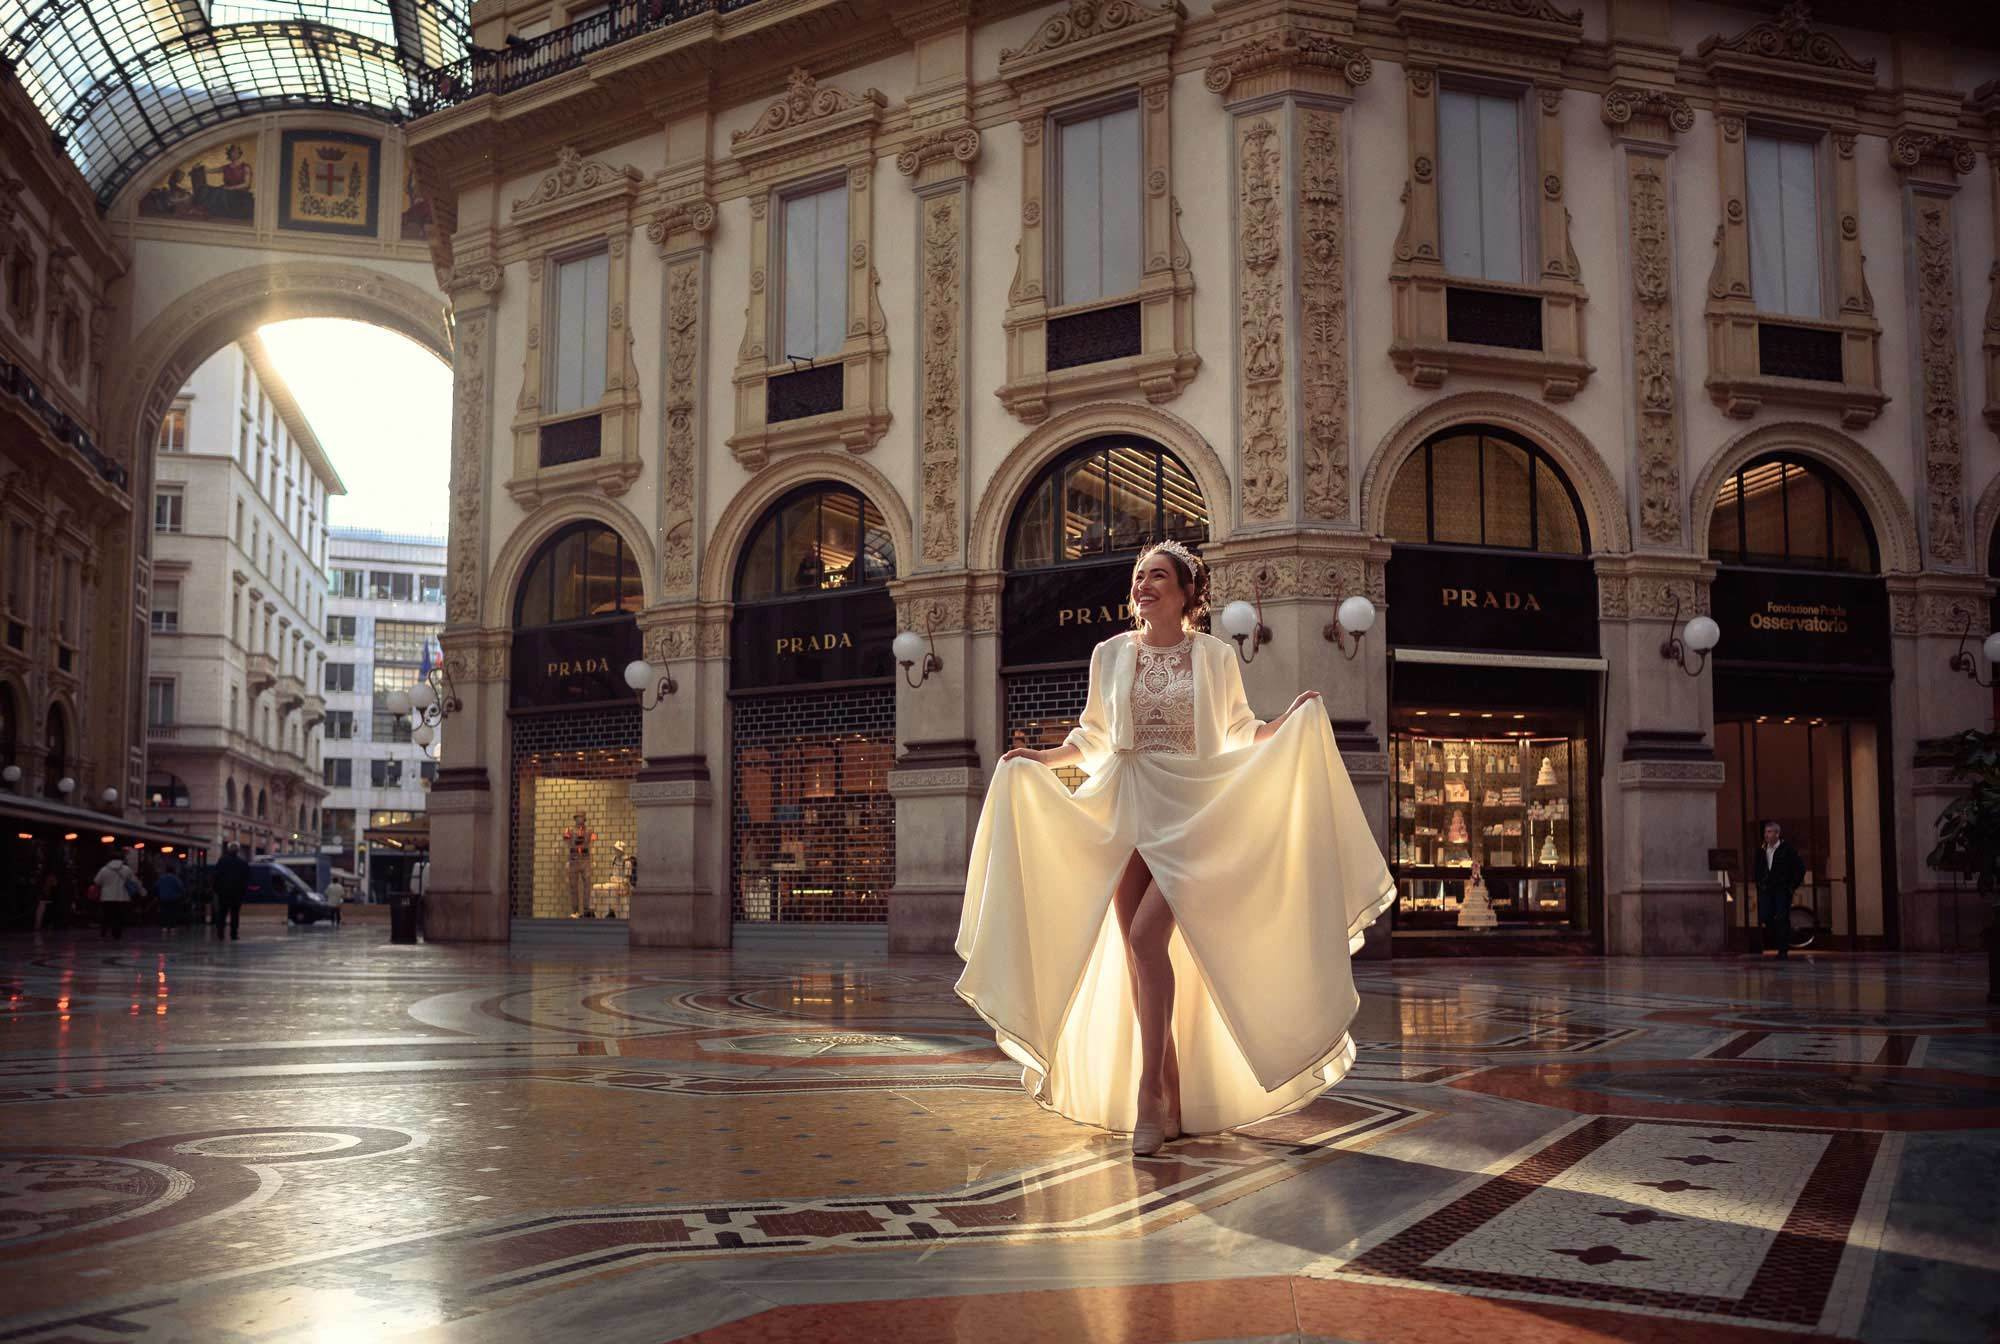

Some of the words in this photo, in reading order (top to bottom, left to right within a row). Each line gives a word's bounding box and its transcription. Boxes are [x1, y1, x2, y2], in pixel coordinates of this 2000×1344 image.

[1441, 588, 1541, 611] PRADA
[1058, 603, 1131, 627] PRAD
[1750, 612, 1848, 633] Osservatorio
[776, 632, 853, 655] PRADA
[547, 657, 609, 678] PRADA
